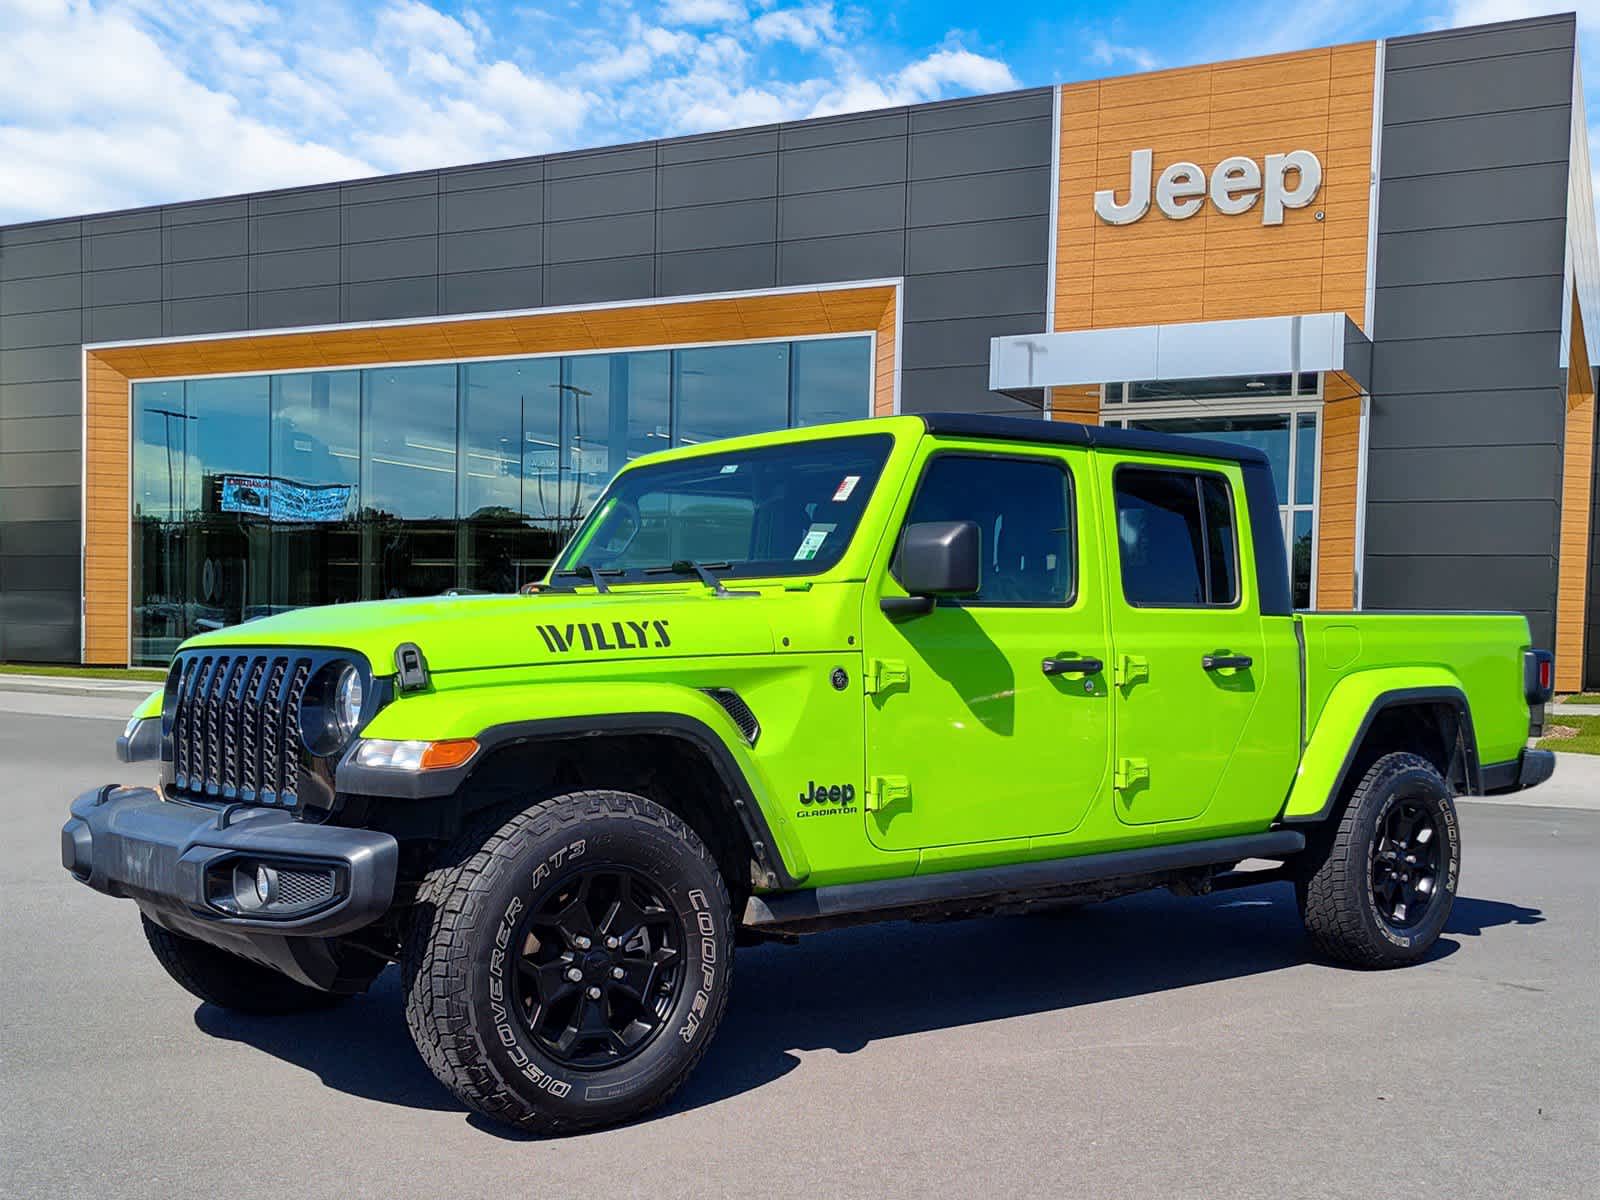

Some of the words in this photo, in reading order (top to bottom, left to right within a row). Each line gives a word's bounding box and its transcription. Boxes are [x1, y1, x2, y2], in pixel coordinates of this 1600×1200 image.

[1094, 148, 1322, 225] Jeep
[536, 620, 671, 653] WILLYS
[796, 806, 858, 818] GLADIATOR
[799, 780, 856, 806] Jeep
[488, 896, 572, 1098] DISCOVERER
[531, 838, 587, 889] AT3
[678, 888, 717, 1043] COOPER
